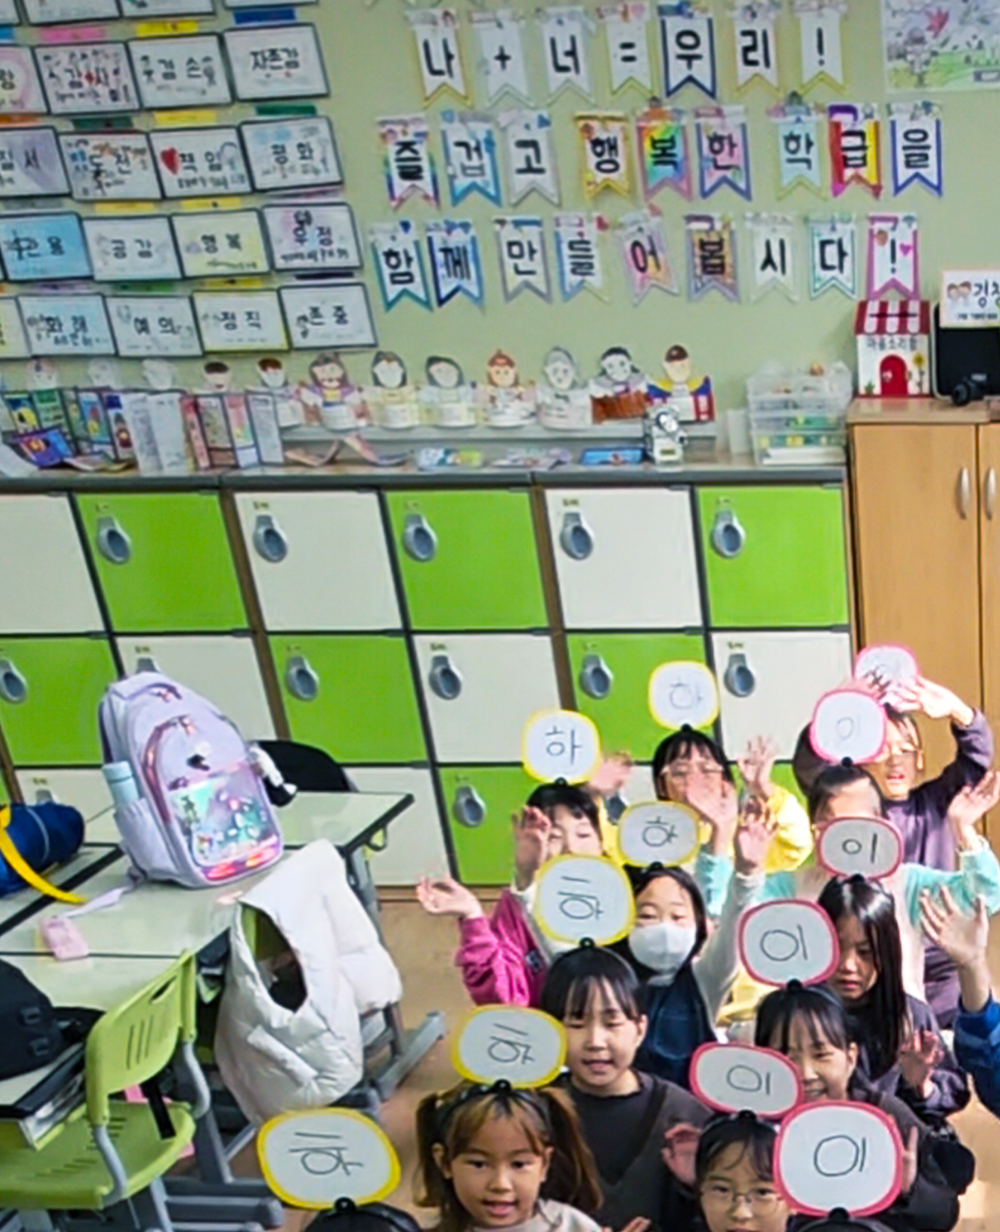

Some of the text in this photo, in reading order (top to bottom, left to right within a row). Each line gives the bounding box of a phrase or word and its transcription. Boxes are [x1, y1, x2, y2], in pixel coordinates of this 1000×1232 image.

[394, 129, 931, 182] 즐겁고 행복한 학급을
[382, 244, 471, 285] 함께
[669, 682, 704, 710] 하
[545, 725, 582, 765] 하
[641, 820, 679, 848] 하
[842, 832, 879, 864] 이
[558, 876, 605, 922] 하
[760, 924, 809, 962] 이
[487, 1023, 537, 1064] 하
[726, 1064, 773, 1097] 이
[287, 1132, 366, 1178] 하
[814, 1134, 868, 1178] 이
